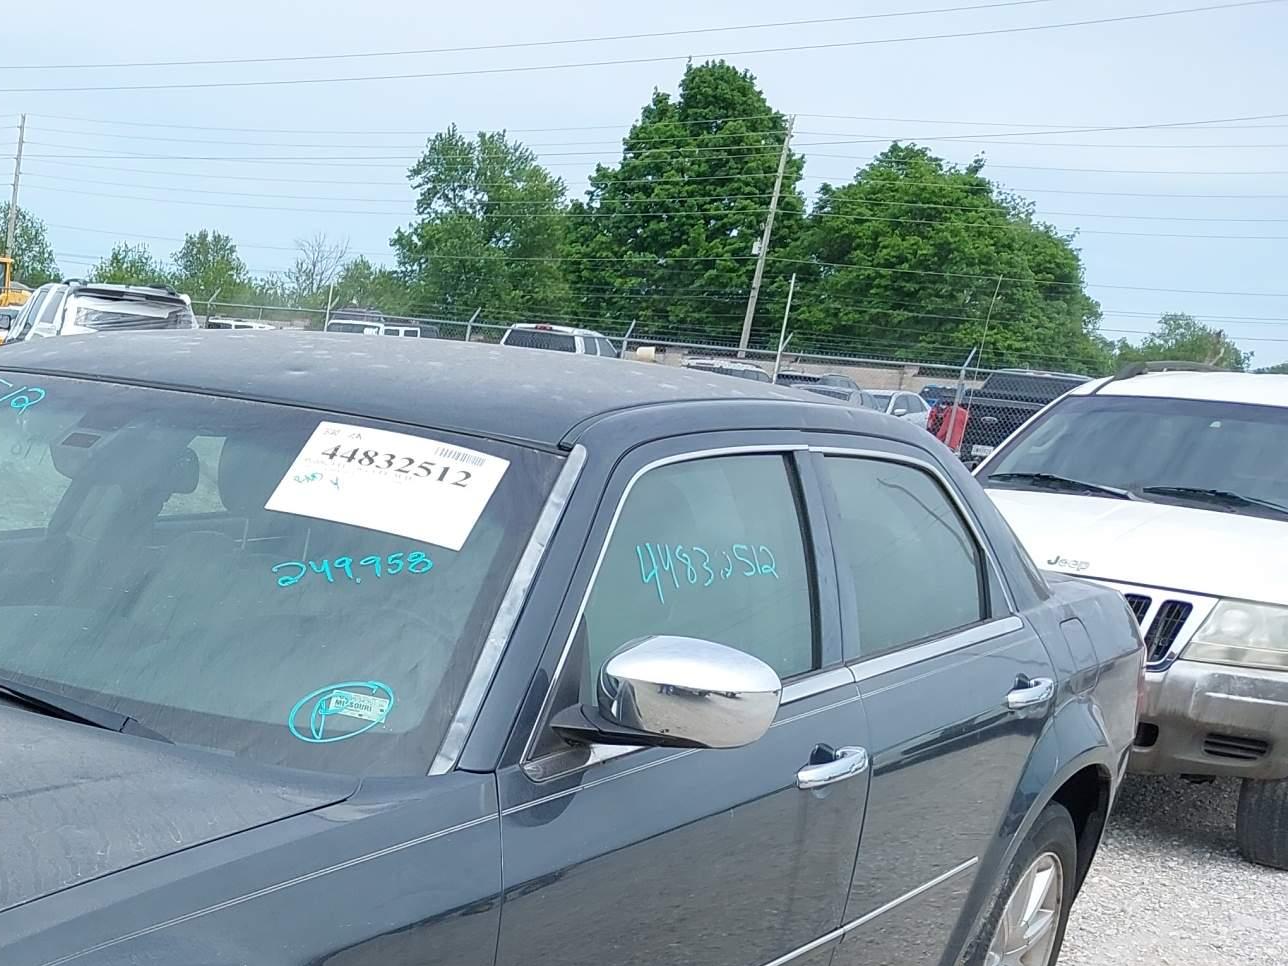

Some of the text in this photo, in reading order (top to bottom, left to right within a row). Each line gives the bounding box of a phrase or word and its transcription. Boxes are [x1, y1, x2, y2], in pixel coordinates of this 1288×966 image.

[321, 444, 472, 488] 44832512
[636, 543, 779, 604] 44832512
[1047, 555, 1090, 571] Jeep
